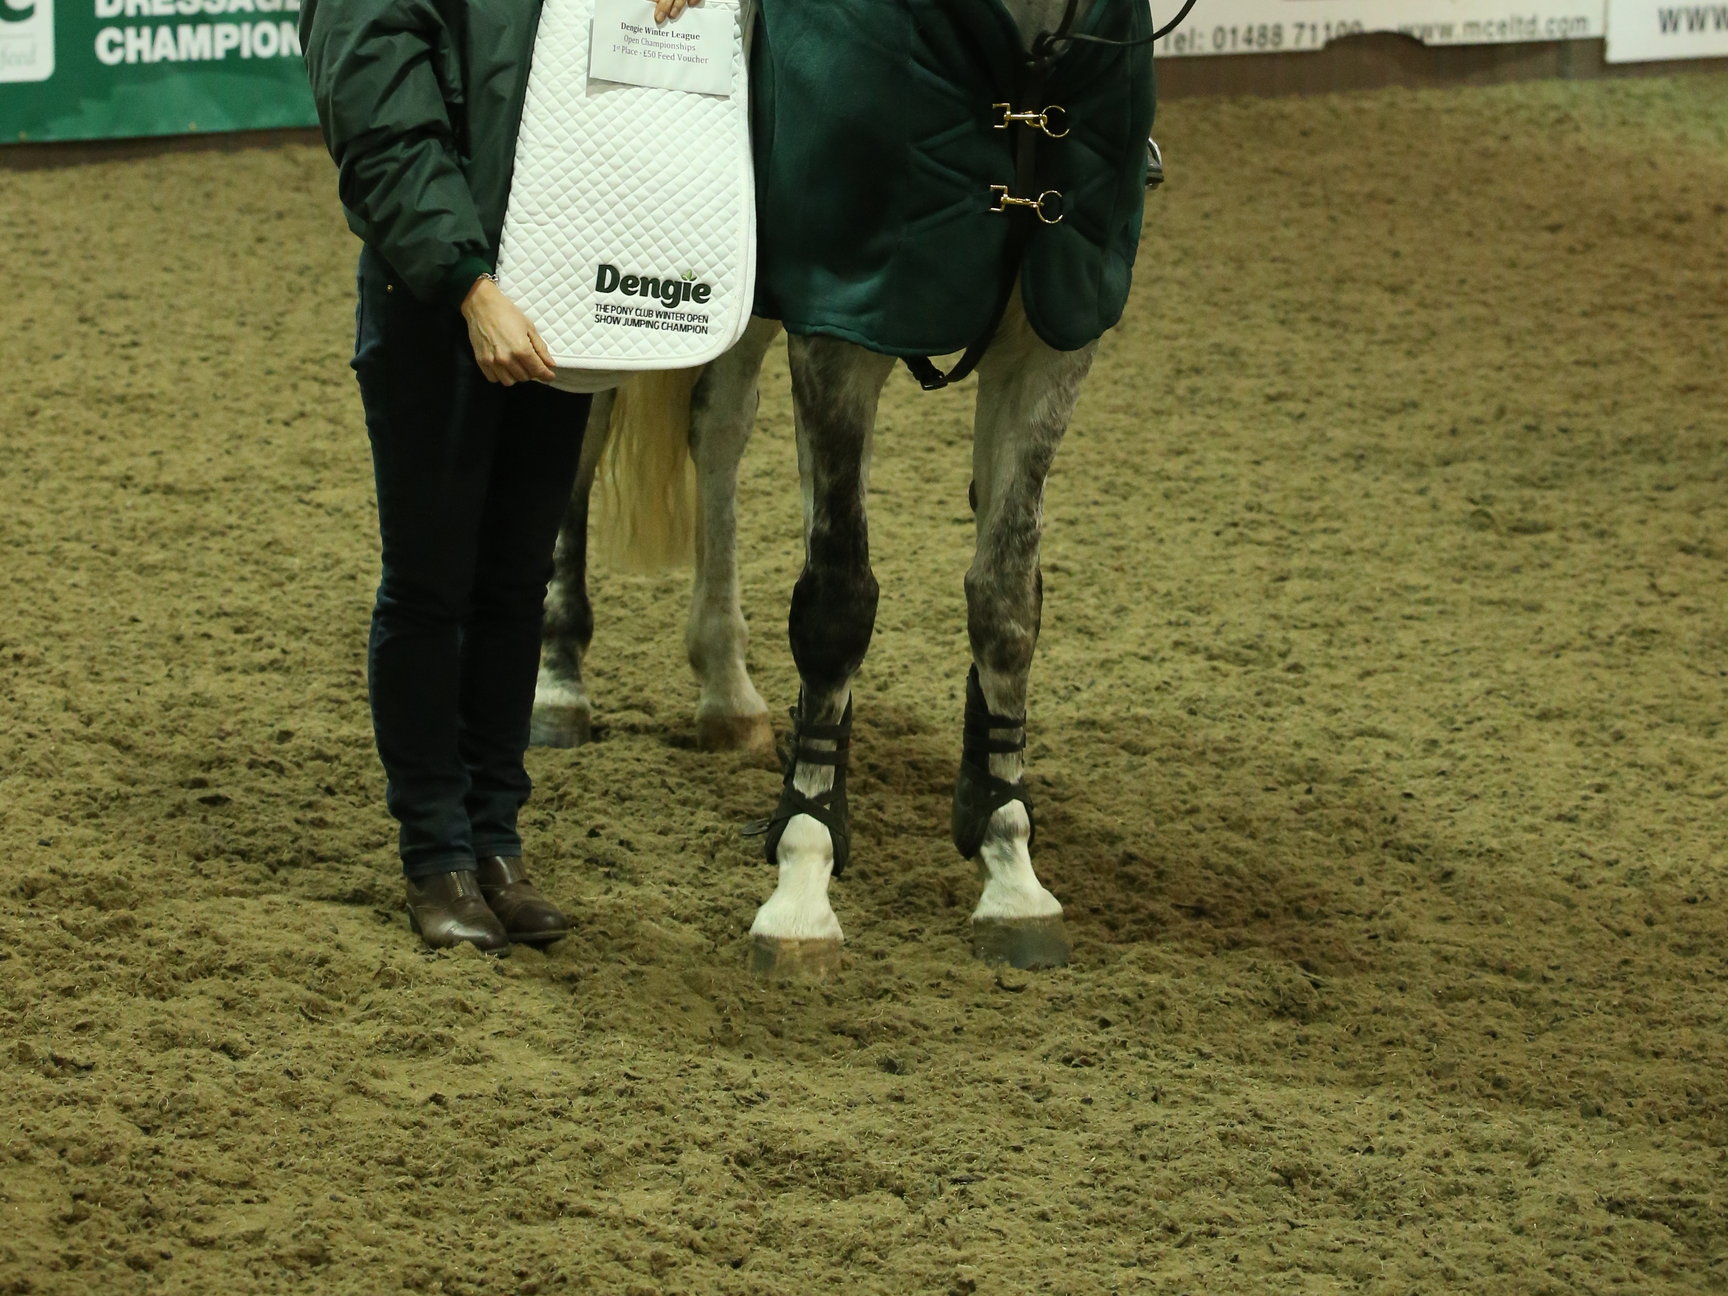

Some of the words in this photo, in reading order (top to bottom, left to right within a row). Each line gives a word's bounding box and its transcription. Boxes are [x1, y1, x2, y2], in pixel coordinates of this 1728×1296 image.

[620, 22, 643, 34] Dengie
[645, 27, 669, 37] Winter
[671, 31, 700, 41] League
[1213, 23, 1283, 50] 01488
[624, 35, 640, 45] Open
[641, 37, 696, 52] Championships
[622, 45, 638, 56] Place
[644, 50, 656, 58] £50
[658, 52, 675, 61] Feed
[679, 53, 709, 64] Voucher
[595, 264, 712, 309] Dengie
[596, 304, 610, 314] THE
[611, 306, 634, 317] PONY
[635, 308, 654, 318] CLUB
[656, 311, 686, 322] WINTER
[687, 314, 709, 324] OPEN
[594, 315, 621, 326] SHOW
[622, 317, 660, 331] JUMPING
[661, 321, 709, 335] CHAMPION
